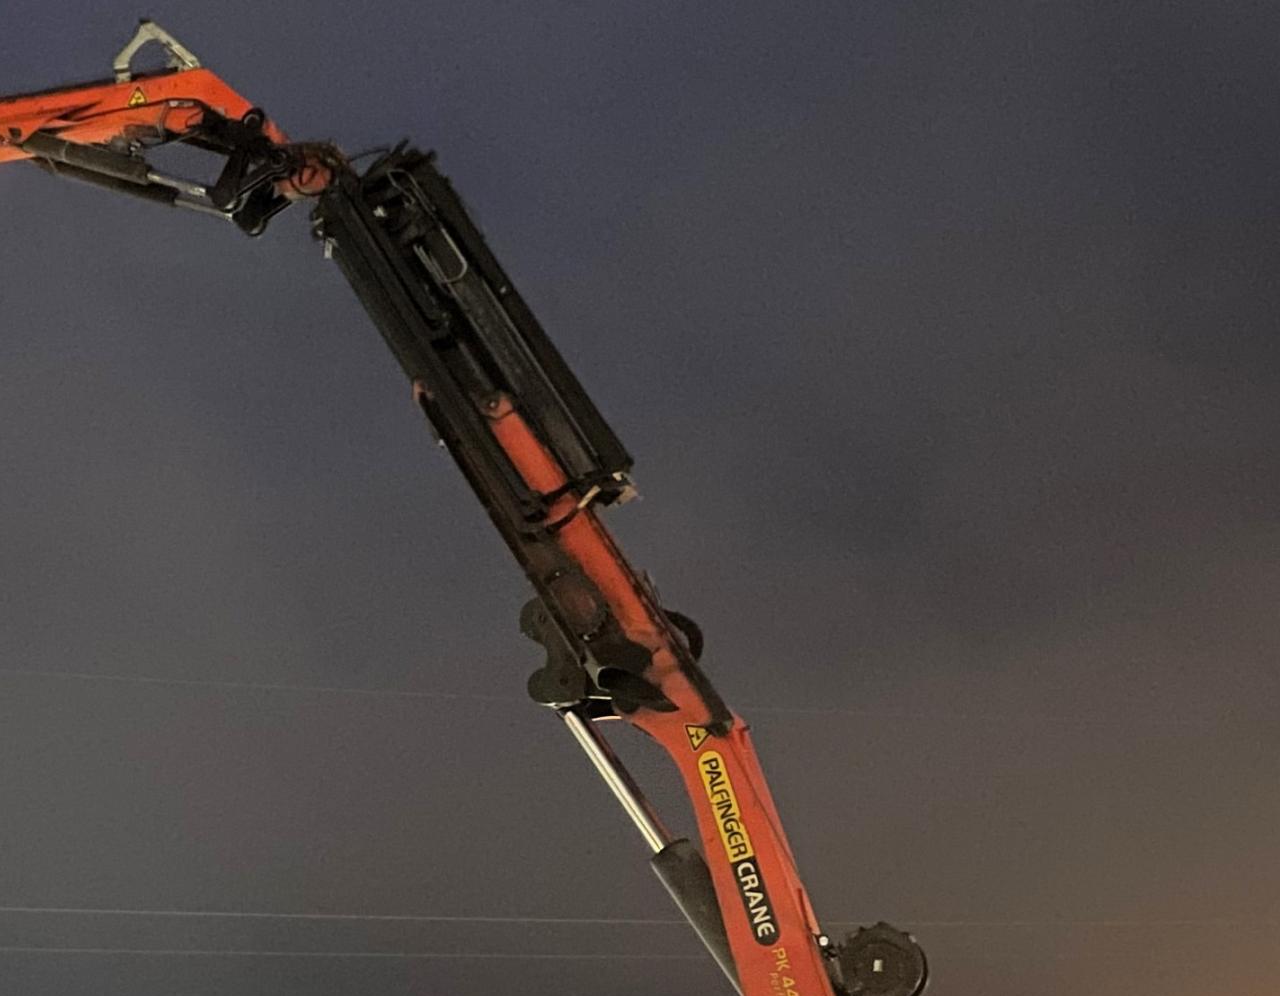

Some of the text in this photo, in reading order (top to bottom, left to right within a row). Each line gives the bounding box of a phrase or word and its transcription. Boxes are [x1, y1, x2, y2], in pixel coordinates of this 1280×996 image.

[702, 757, 776, 938] PALFINGER CRANE
[771, 947, 791, 972] PK
